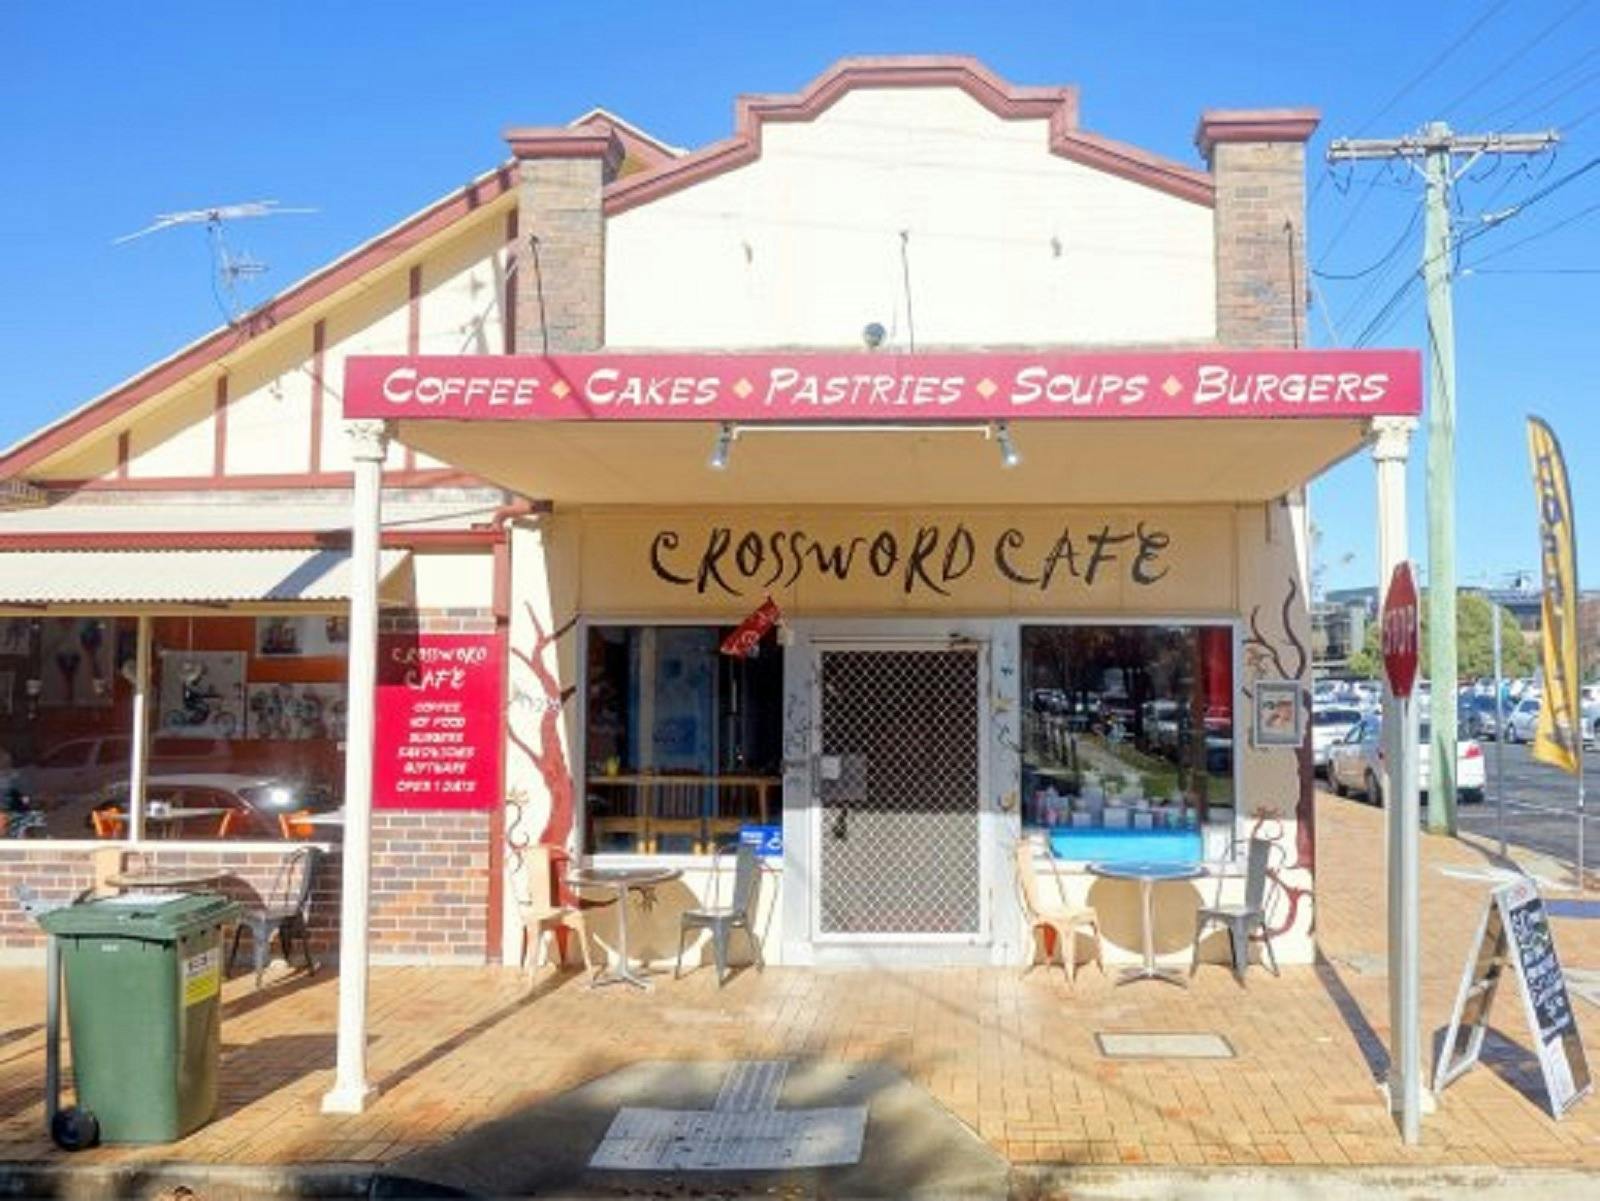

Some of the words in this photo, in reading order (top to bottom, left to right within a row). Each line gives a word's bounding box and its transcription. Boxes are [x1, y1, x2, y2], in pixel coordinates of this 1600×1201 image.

[382, 367, 540, 406] COFFEE
[584, 368, 721, 407] CAKES
[764, 366, 966, 406] PASTRIES
[1010, 365, 1149, 405] SOUPS
[1193, 365, 1389, 405] BURGERS
[650, 522, 976, 597] CROSSWORD
[1383, 603, 1416, 656] STOP
